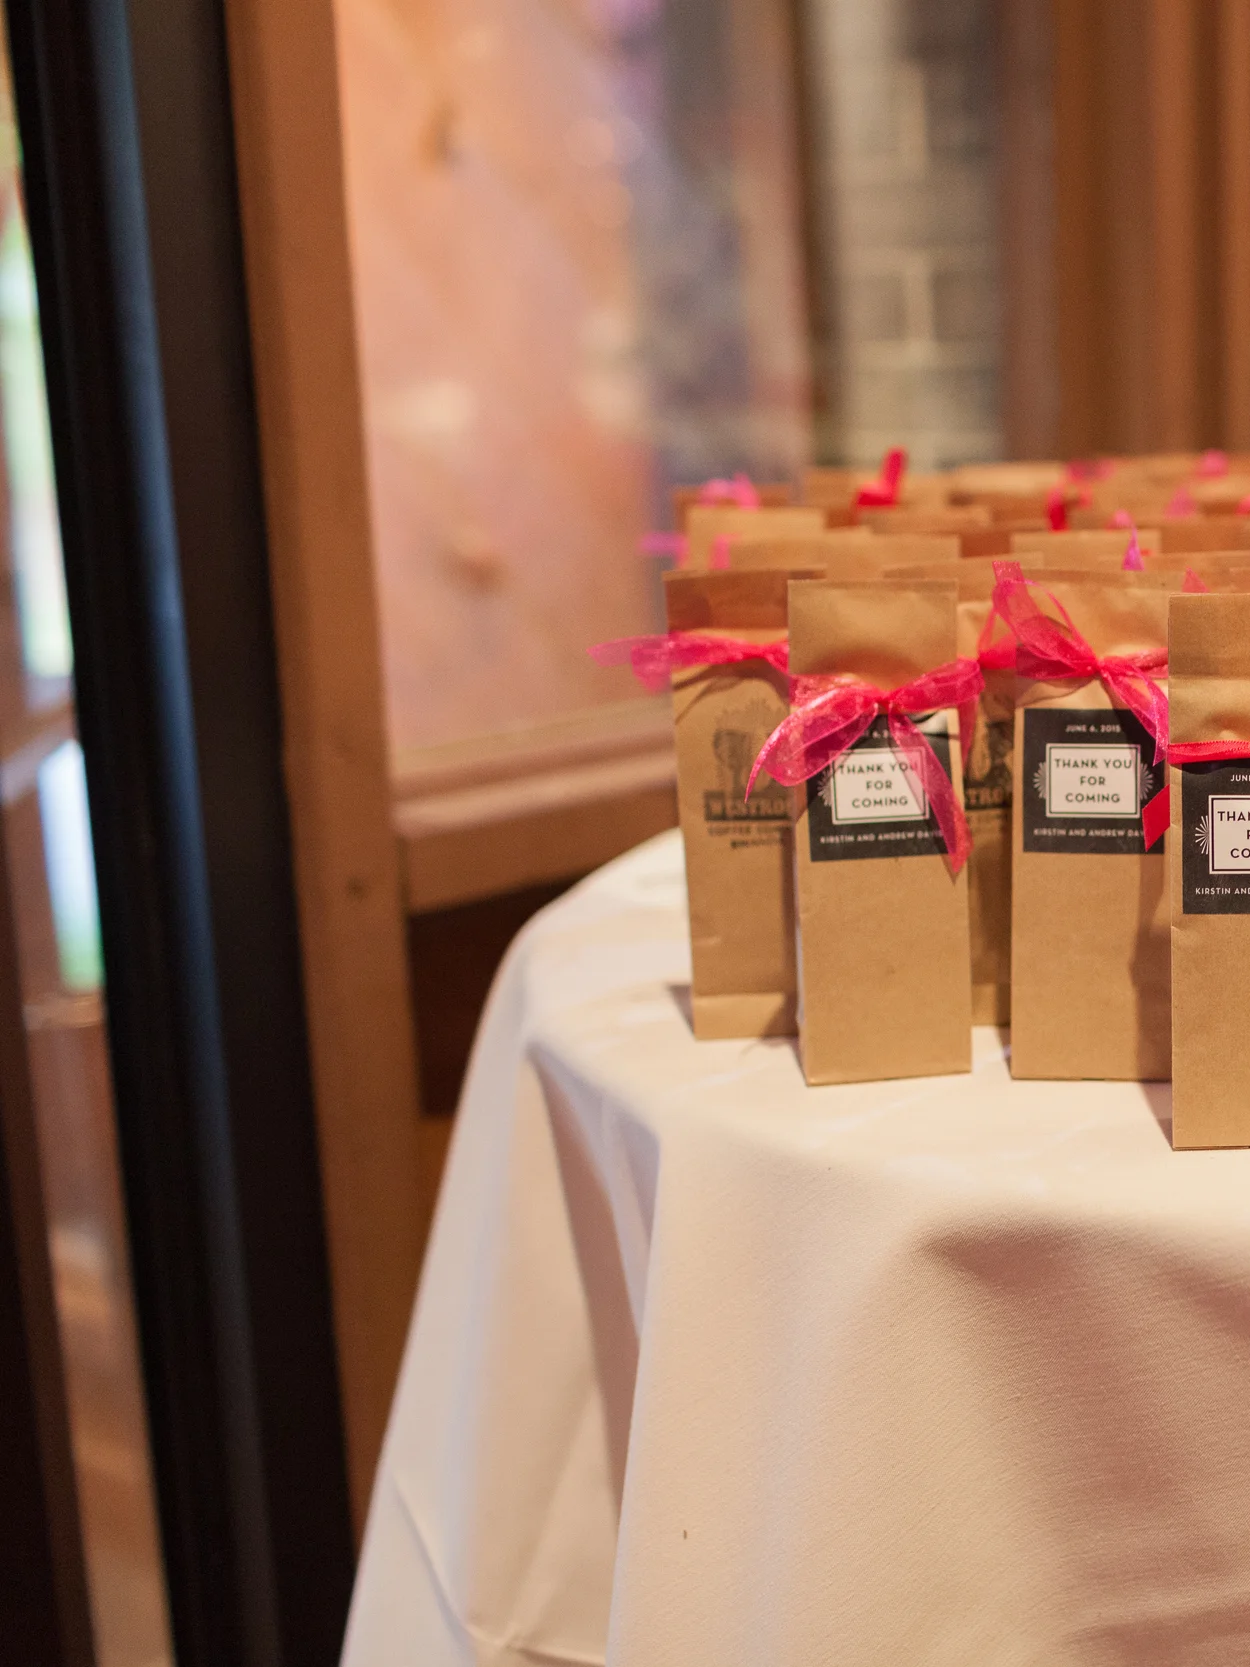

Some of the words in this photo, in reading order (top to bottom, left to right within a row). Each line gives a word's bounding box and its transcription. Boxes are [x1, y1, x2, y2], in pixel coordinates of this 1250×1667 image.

[1065, 724, 1087, 733] JUNE
[1100, 724, 1121, 733] 2015
[1054, 758, 1098, 769] THANK
[1103, 758, 1132, 769] YOU
[839, 764, 884, 775] THANK
[866, 780, 893, 790] FOR
[1080, 776, 1106, 786] FOR
[852, 796, 908, 808] COMING
[1065, 793, 1120, 804] COMING
[857, 833, 875, 842] AND
[878, 832, 915, 841] ANDREW
[1034, 827, 1066, 837] KIRSTIN
[1069, 828, 1086, 837] AND
[1089, 828, 1124, 837] ANDREW
[1195, 887, 1231, 895] KIRSTIN
